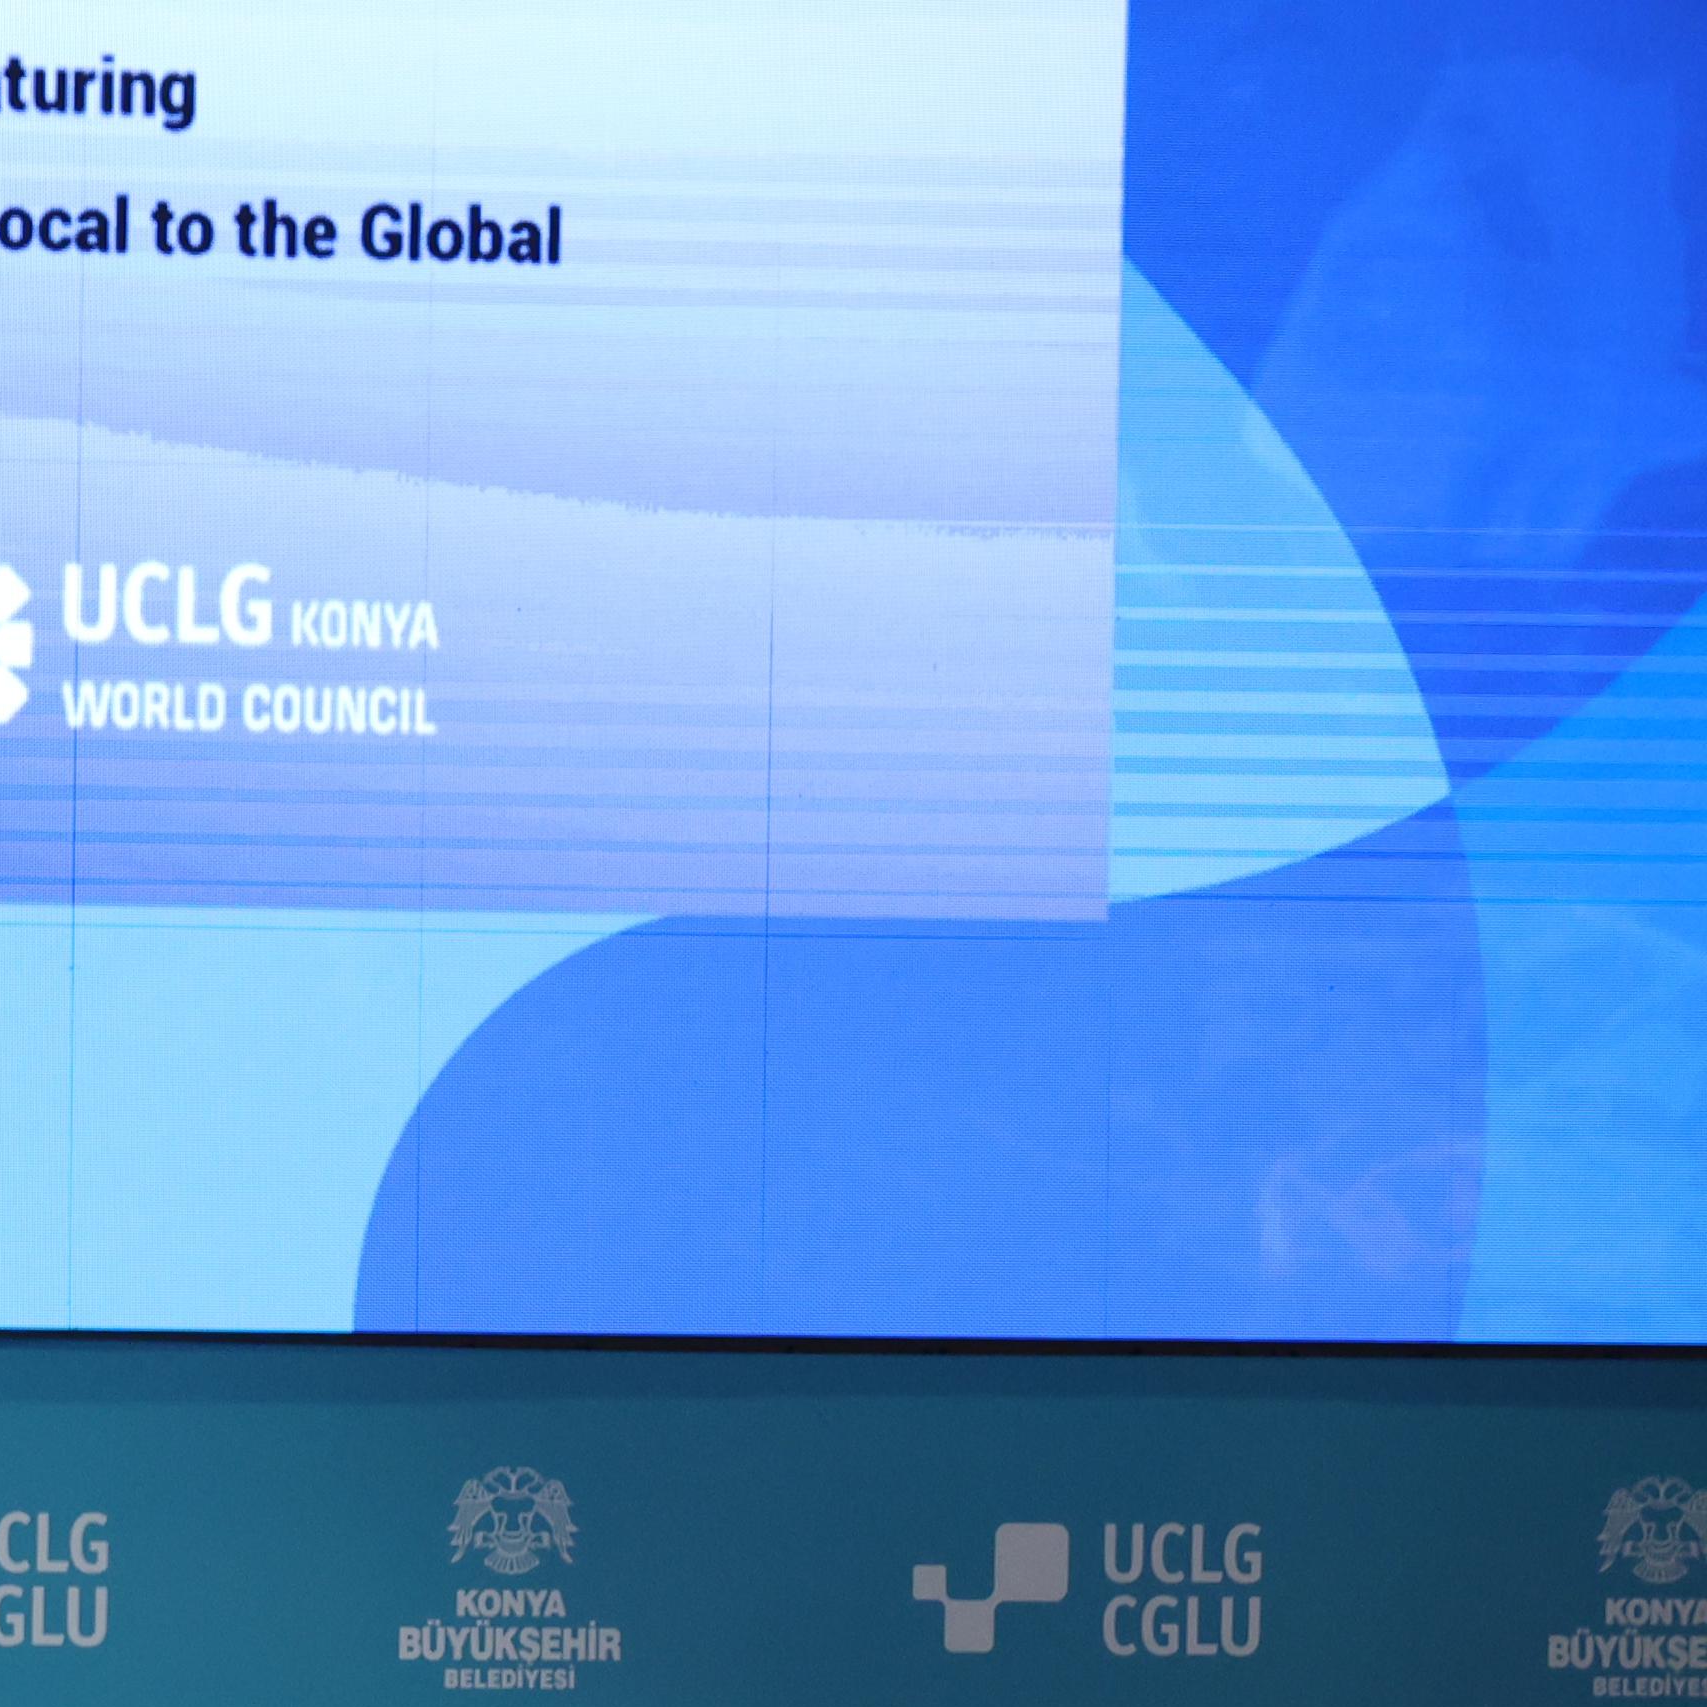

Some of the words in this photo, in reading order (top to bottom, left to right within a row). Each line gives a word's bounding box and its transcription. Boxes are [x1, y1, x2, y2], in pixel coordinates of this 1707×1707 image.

[149, 199, 216, 257] to
[233, 197, 338, 260] the
[359, 201, 562, 266] Global
[62, 559, 274, 648] UCLG
[291, 598, 441, 651] KONYA
[61, 678, 228, 733] WORLD
[242, 682, 438, 737] COUNCIL
[1104, 1522, 1263, 1585] UCLG
[456, 1588, 567, 1619] KONYA
[1102, 1594, 1262, 1657] CGLU
[1605, 1597, 1707, 1627] KONYA
[398, 1618, 621, 1665] BÜYÜKŞEHİR
[443, 1663, 576, 1690] BELEDİYESİ
